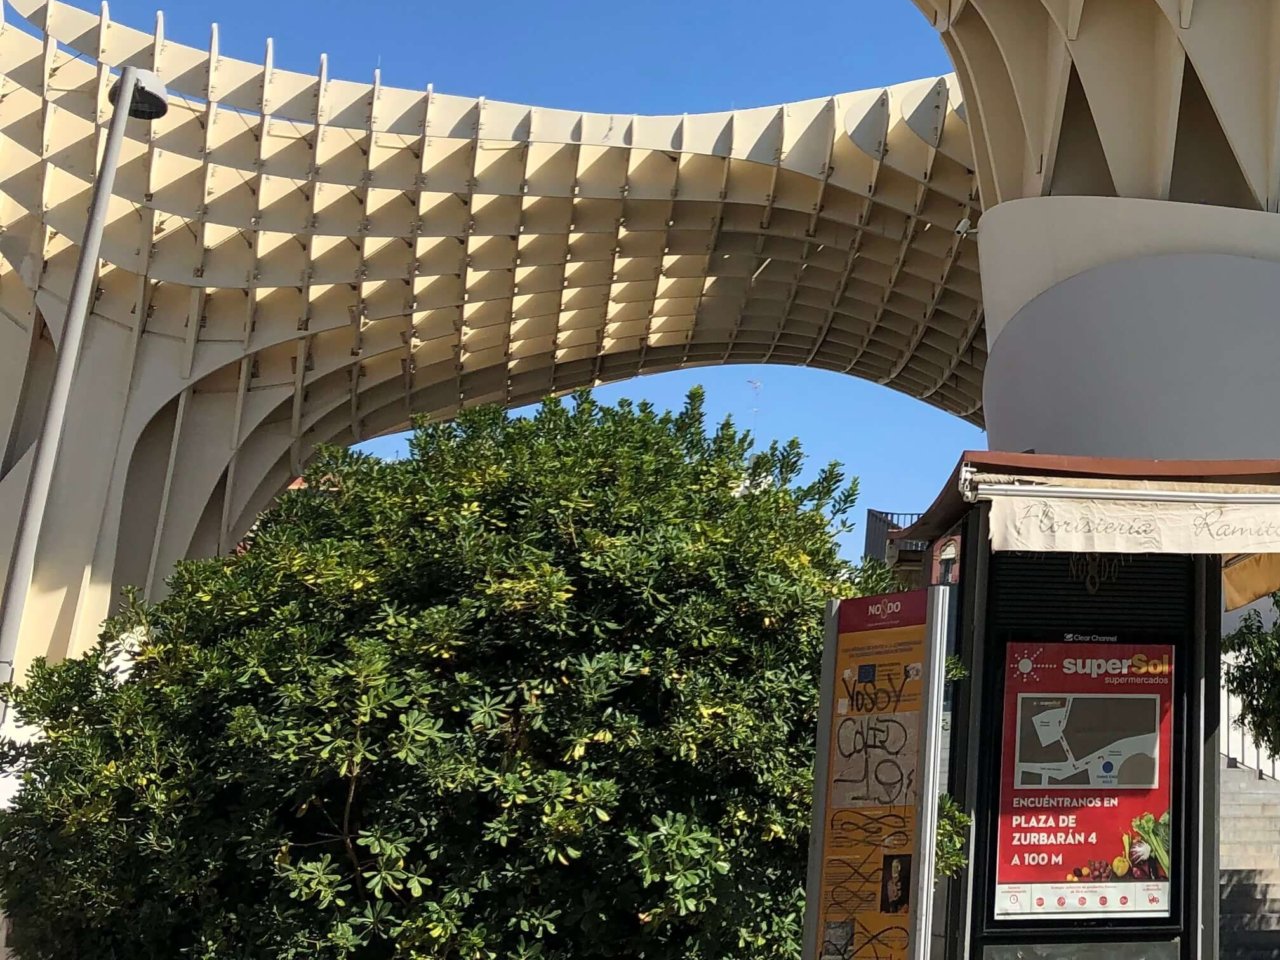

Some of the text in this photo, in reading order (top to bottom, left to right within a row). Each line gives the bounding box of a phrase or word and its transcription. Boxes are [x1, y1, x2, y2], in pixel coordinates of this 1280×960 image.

[1091, 634, 1117, 642] Channel
[1062, 654, 1169, 678] superSol
[1104, 677, 1169, 685] supermercados
[1013, 795, 1118, 808] ENCUÉNTRANOS EN
[1012, 815, 1077, 828] PLAZA DE
[1012, 830, 1097, 846] ZURBARÁN 4
[1011, 853, 1063, 866] A 100 M
